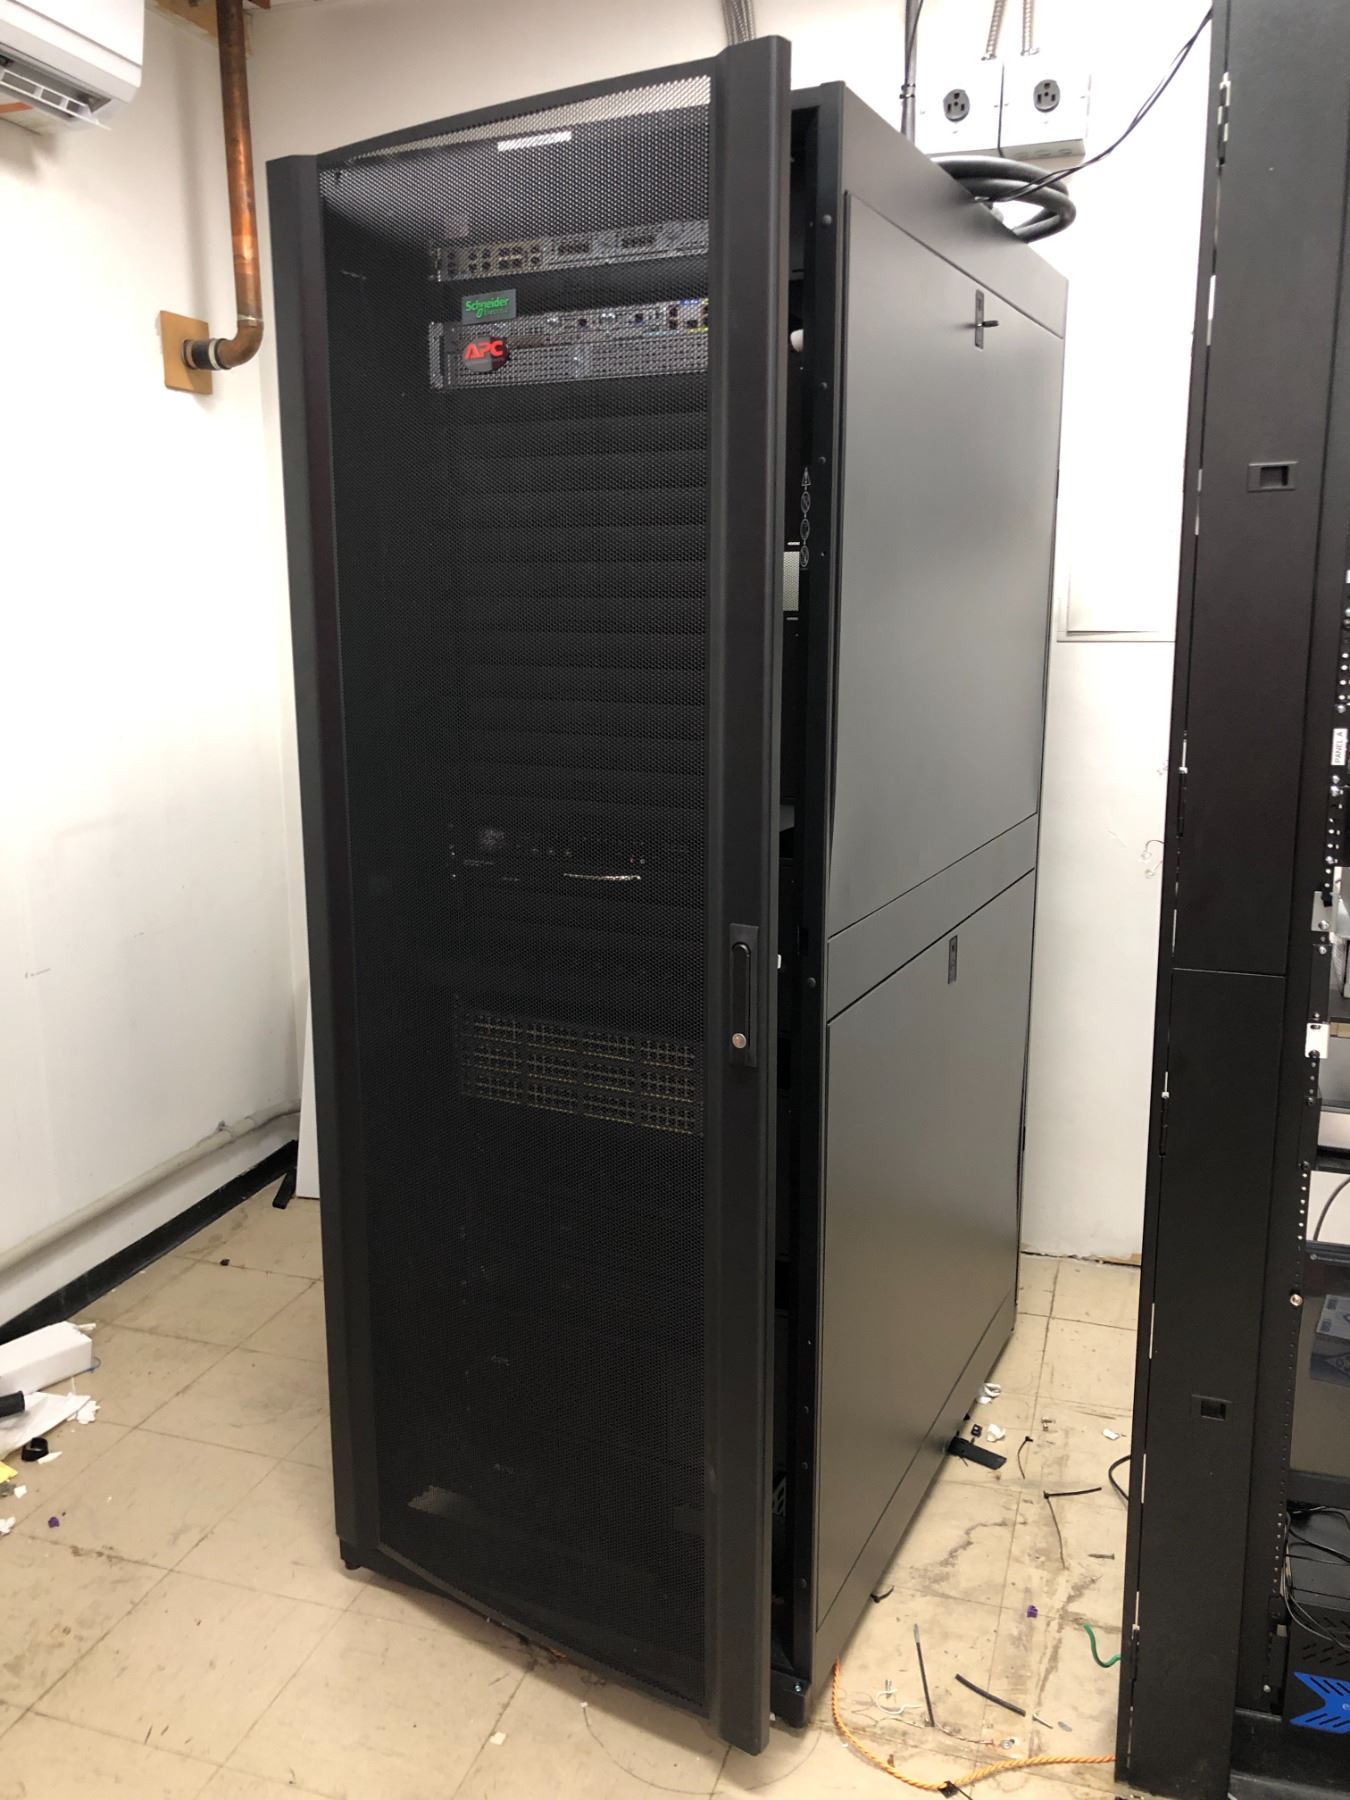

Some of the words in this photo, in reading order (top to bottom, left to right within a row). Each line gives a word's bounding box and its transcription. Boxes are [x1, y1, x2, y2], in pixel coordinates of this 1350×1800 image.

[465, 297, 509, 318] Schneider
[464, 340, 504, 360] APC
[1334, 740, 1344, 764] PANEL
